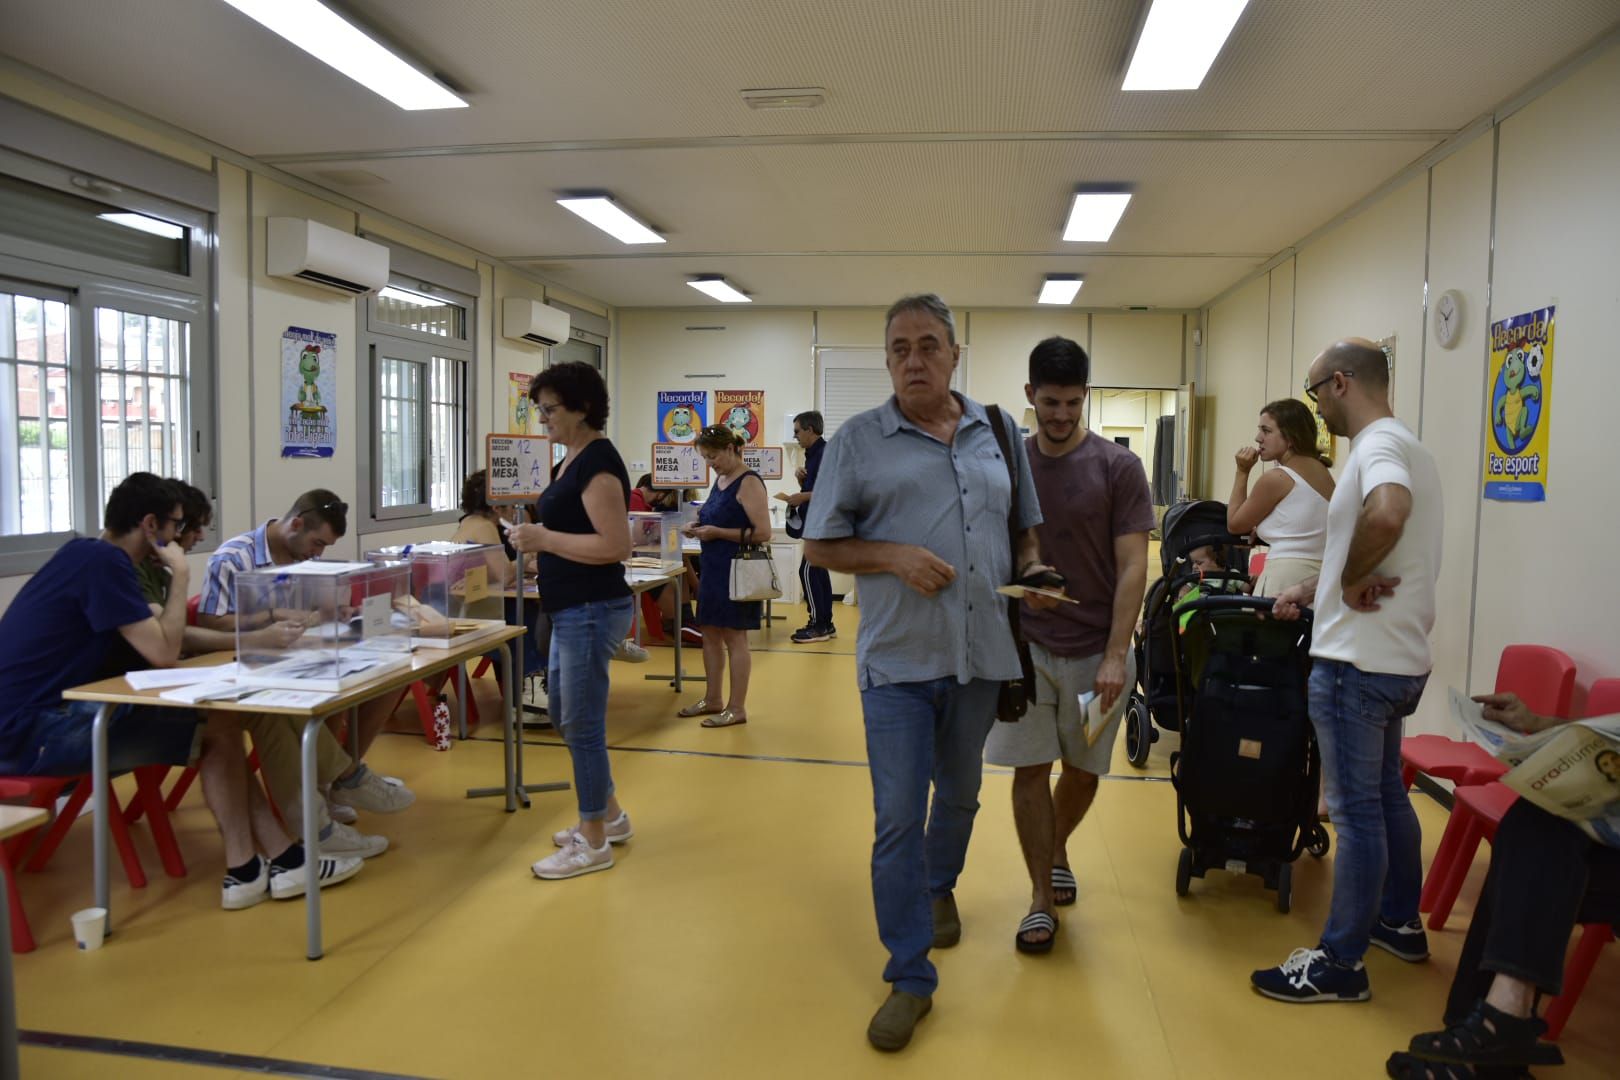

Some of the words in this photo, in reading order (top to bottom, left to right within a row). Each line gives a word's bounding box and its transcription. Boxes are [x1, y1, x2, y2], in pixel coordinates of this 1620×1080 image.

[660, 392, 704, 404] Recorda!
[717, 391, 761, 404] Recorda!
[517, 439, 531, 454] 12
[492, 457, 519, 468] MESA
[656, 457, 679, 465] MESA
[1489, 453, 1504, 473] Fes
[1505, 453, 1539, 477] esport
[492, 468, 519, 479] MESA
[530, 459, 540, 476] A
